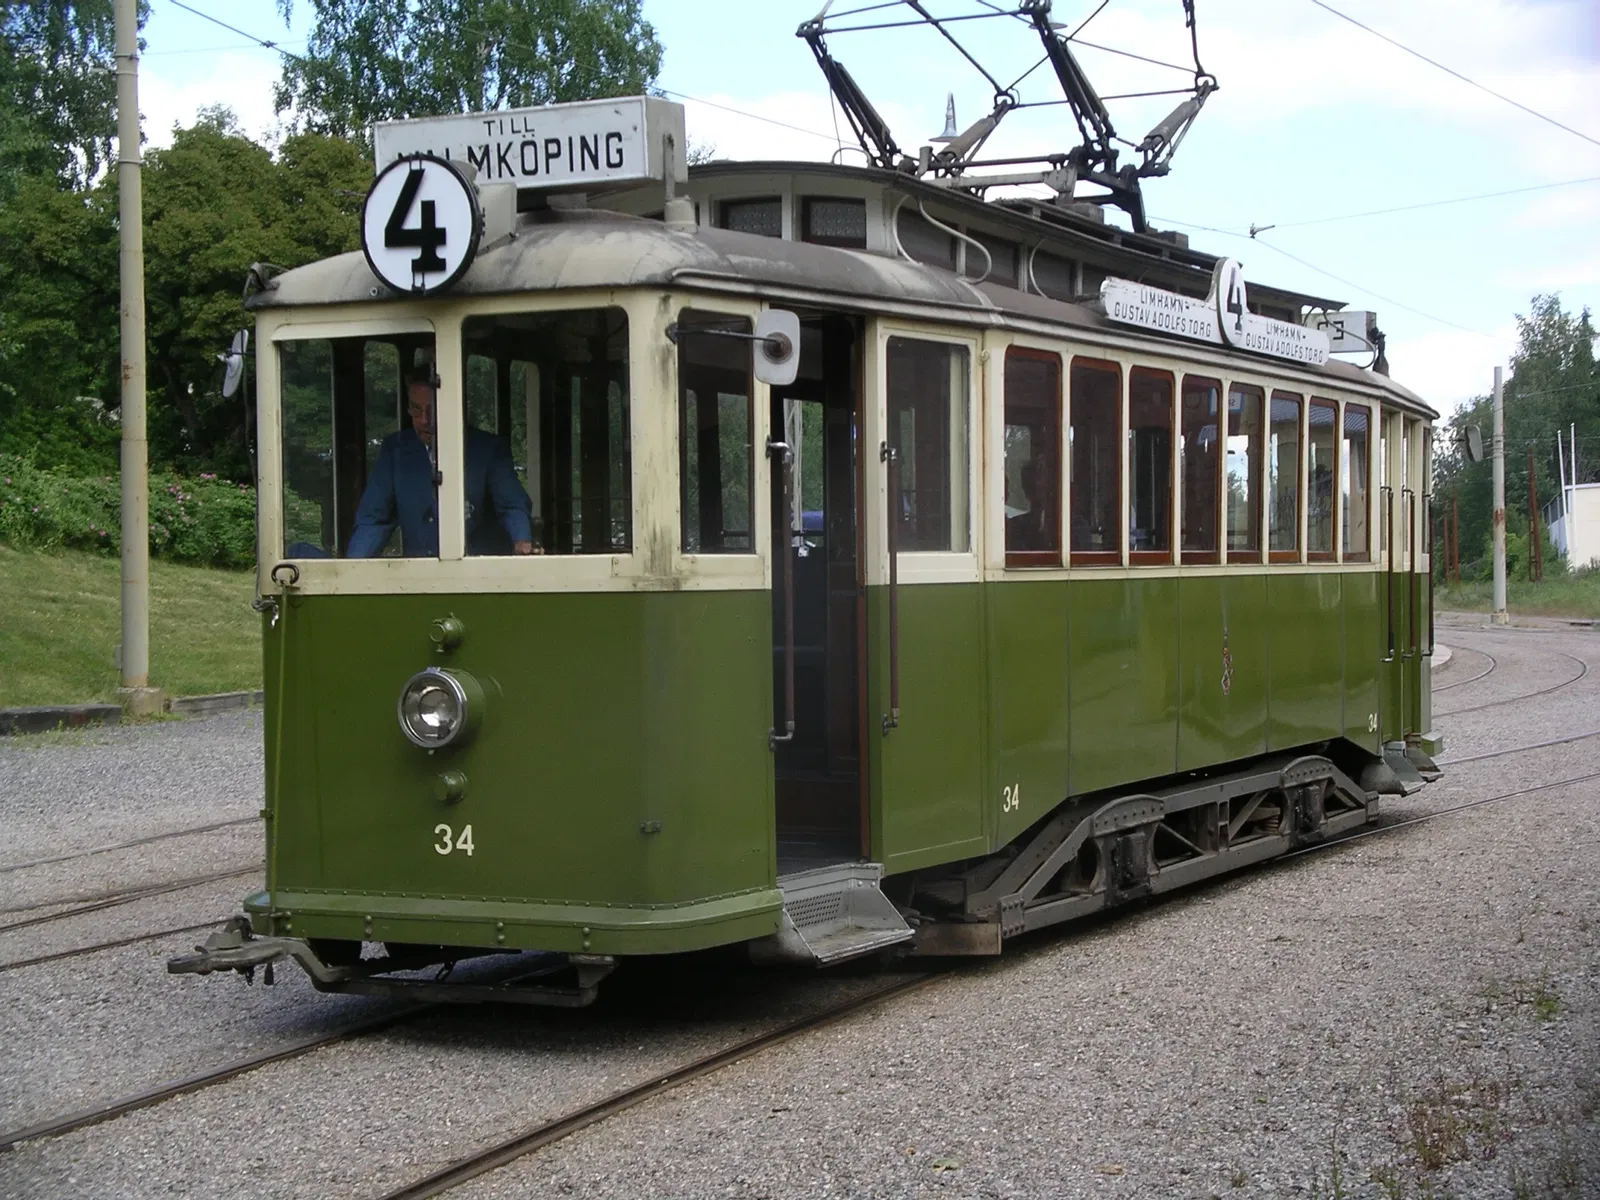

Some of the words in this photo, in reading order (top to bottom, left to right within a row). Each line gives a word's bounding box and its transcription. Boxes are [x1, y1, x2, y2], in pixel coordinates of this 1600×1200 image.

[483, 116, 535, 136] TILL
[398, 131, 624, 181] MKÖPING
[384, 168, 447, 272] 4
[1226, 267, 1243, 332] 4
[1114, 302, 1151, 327] GUSTAV
[1152, 313, 1186, 333] ADOLFS
[1189, 319, 1211, 337] TORG
[1245, 332, 1275, 352] GUSTAV
[1276, 340, 1303, 359] ADOLFS
[1304, 346, 1323, 363] TORG
[1368, 712, 1378, 732] 34
[1003, 783, 1020, 813] 34
[434, 823, 475, 856] 34
